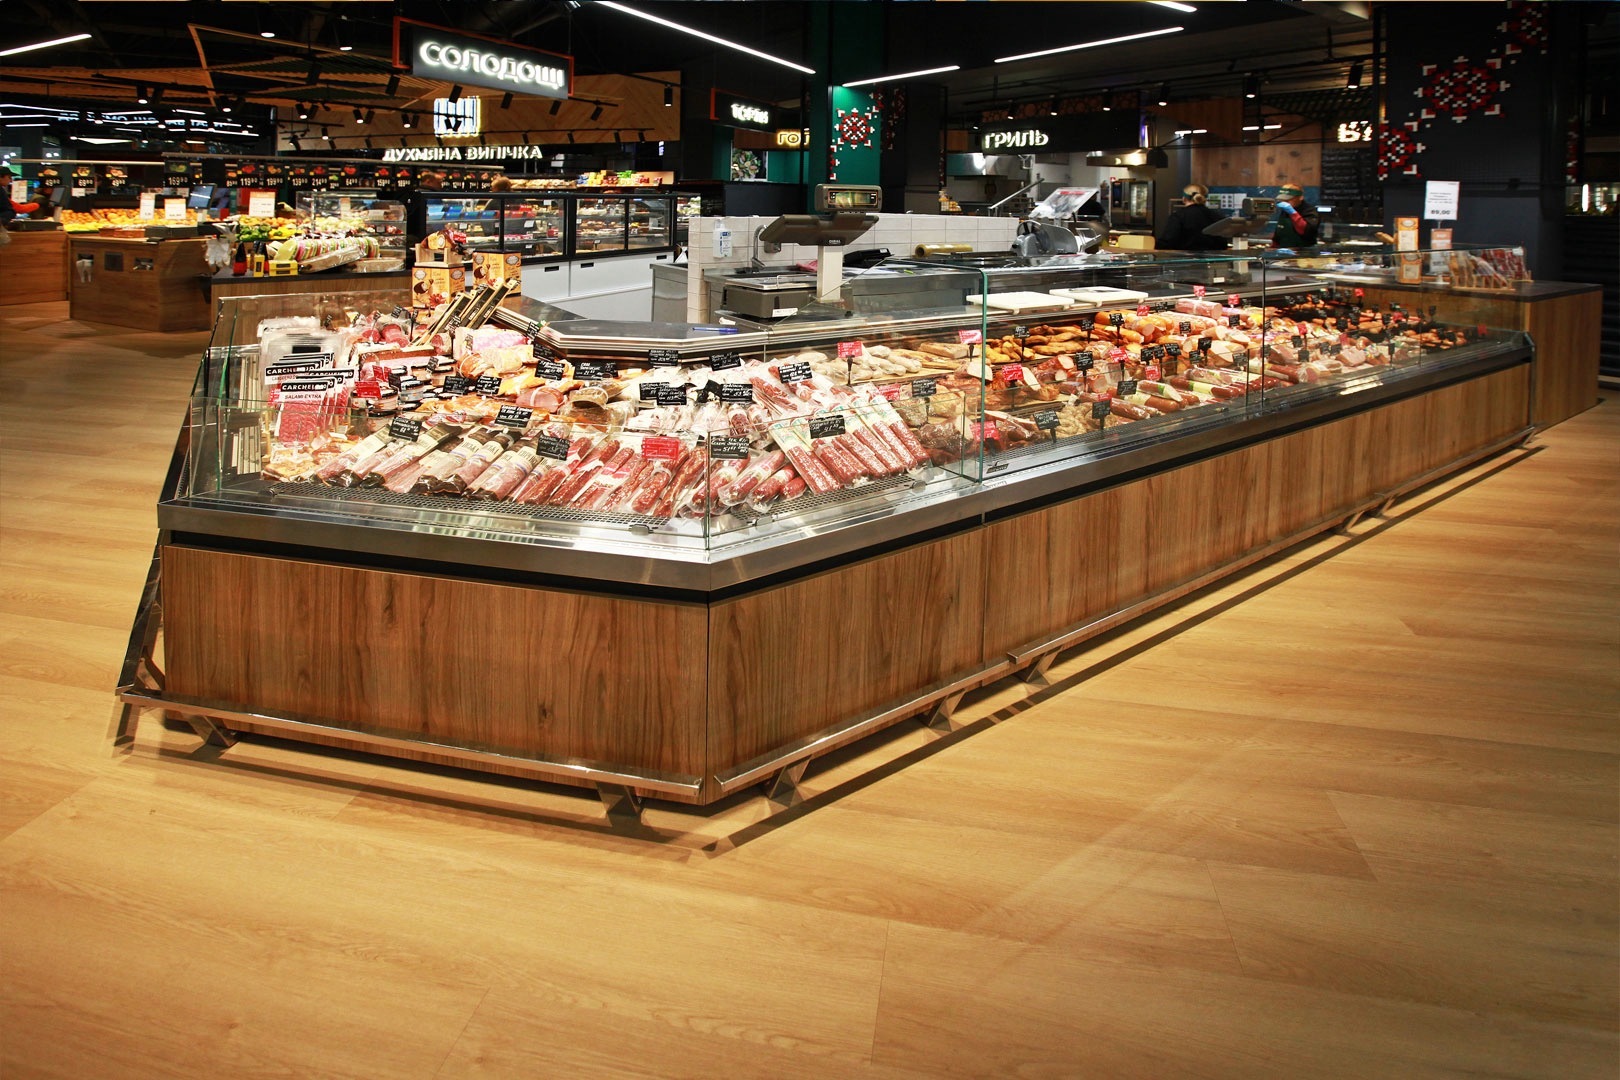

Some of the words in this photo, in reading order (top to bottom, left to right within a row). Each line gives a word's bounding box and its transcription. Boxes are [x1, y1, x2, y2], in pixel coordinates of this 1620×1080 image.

[419, 41, 565, 90] СОЛОДОЩІ
[985, 129, 1049, 149] ГРИЛЬ
[382, 147, 462, 162] ДУХМЯНА
[466, 145, 543, 160] ВИПІЧКА
